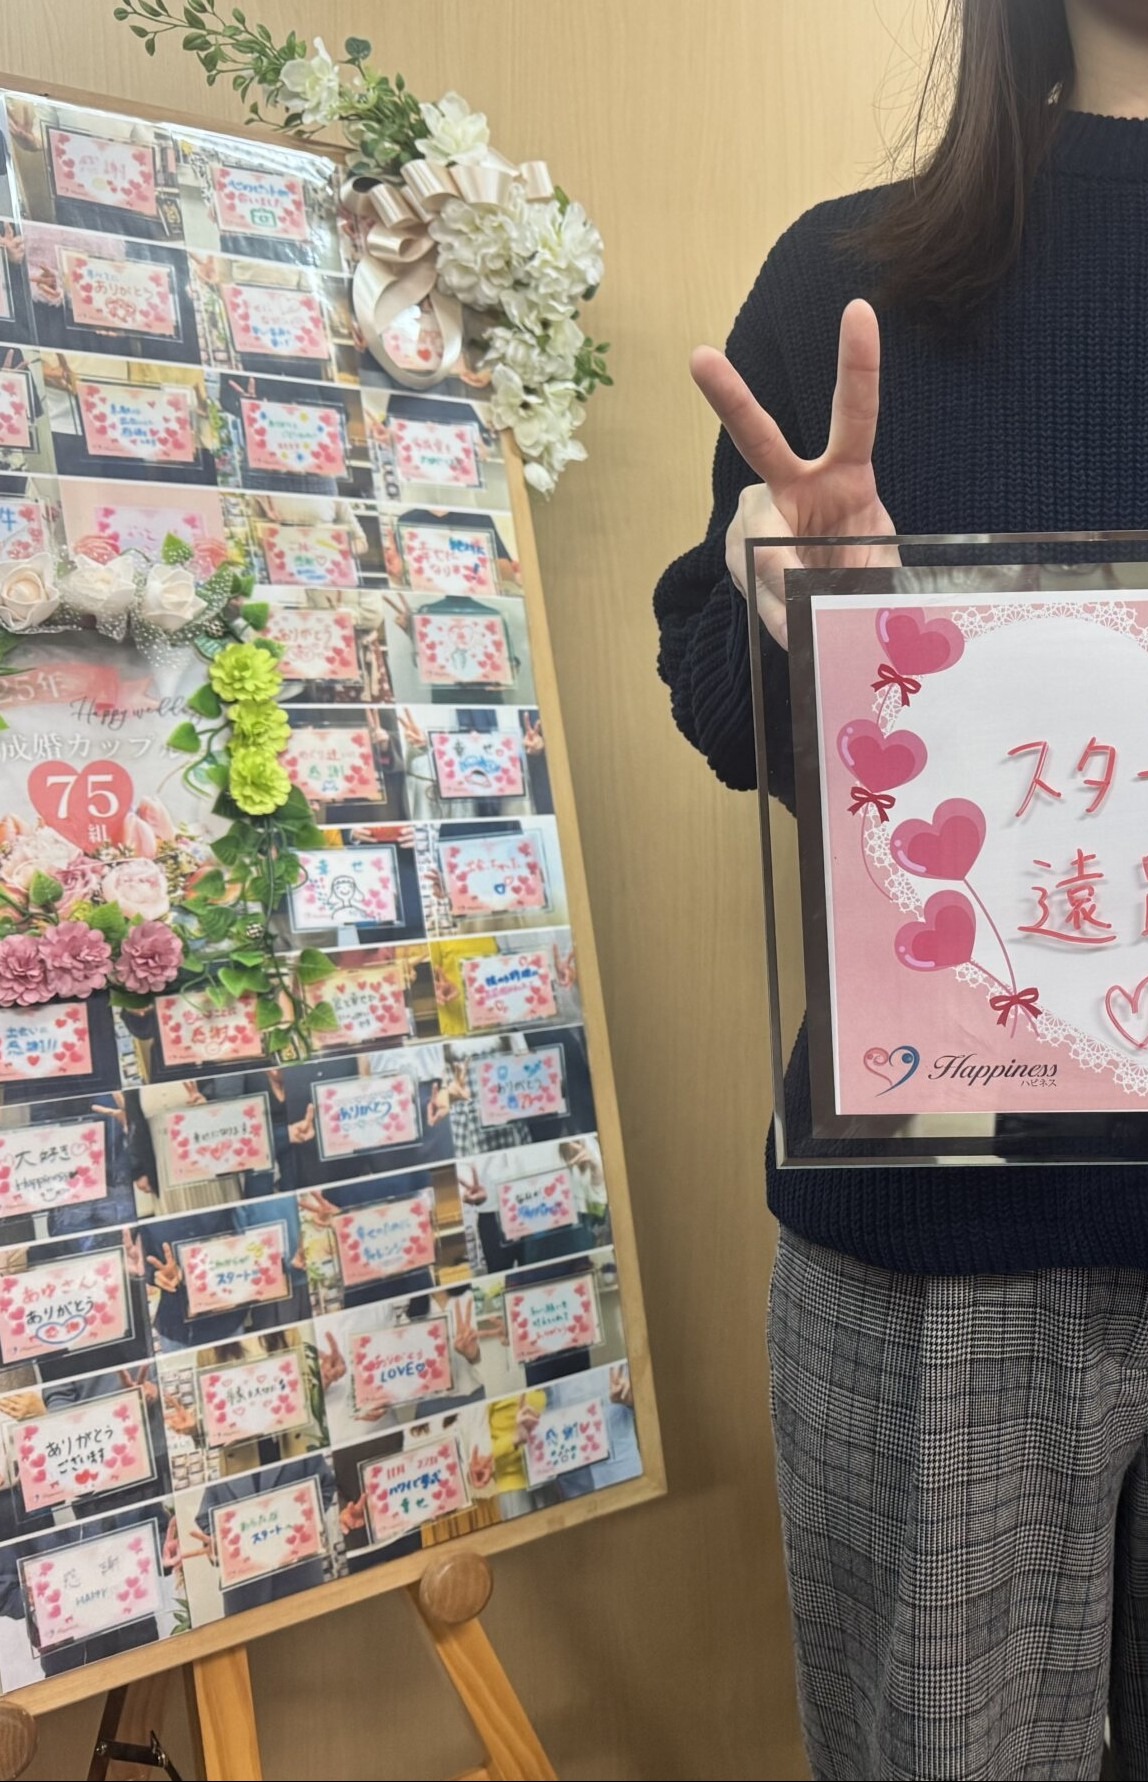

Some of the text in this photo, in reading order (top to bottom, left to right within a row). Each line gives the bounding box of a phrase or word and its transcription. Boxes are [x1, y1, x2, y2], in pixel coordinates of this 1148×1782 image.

[69, 695, 127, 731] Happy
[46, 774, 119, 820] 75
[88, 823, 107, 844] 組
[928, 1053, 1058, 1086] Happiness
[1020, 1079, 1058, 1088] ハピネス
[14, 1144, 72, 1169] 大好き
[26, 1296, 95, 1325] ありがとう
[380, 1361, 415, 1383] LOVE
[45, 1424, 114, 1458] ありがとう
[57, 1447, 105, 1475] ございます
